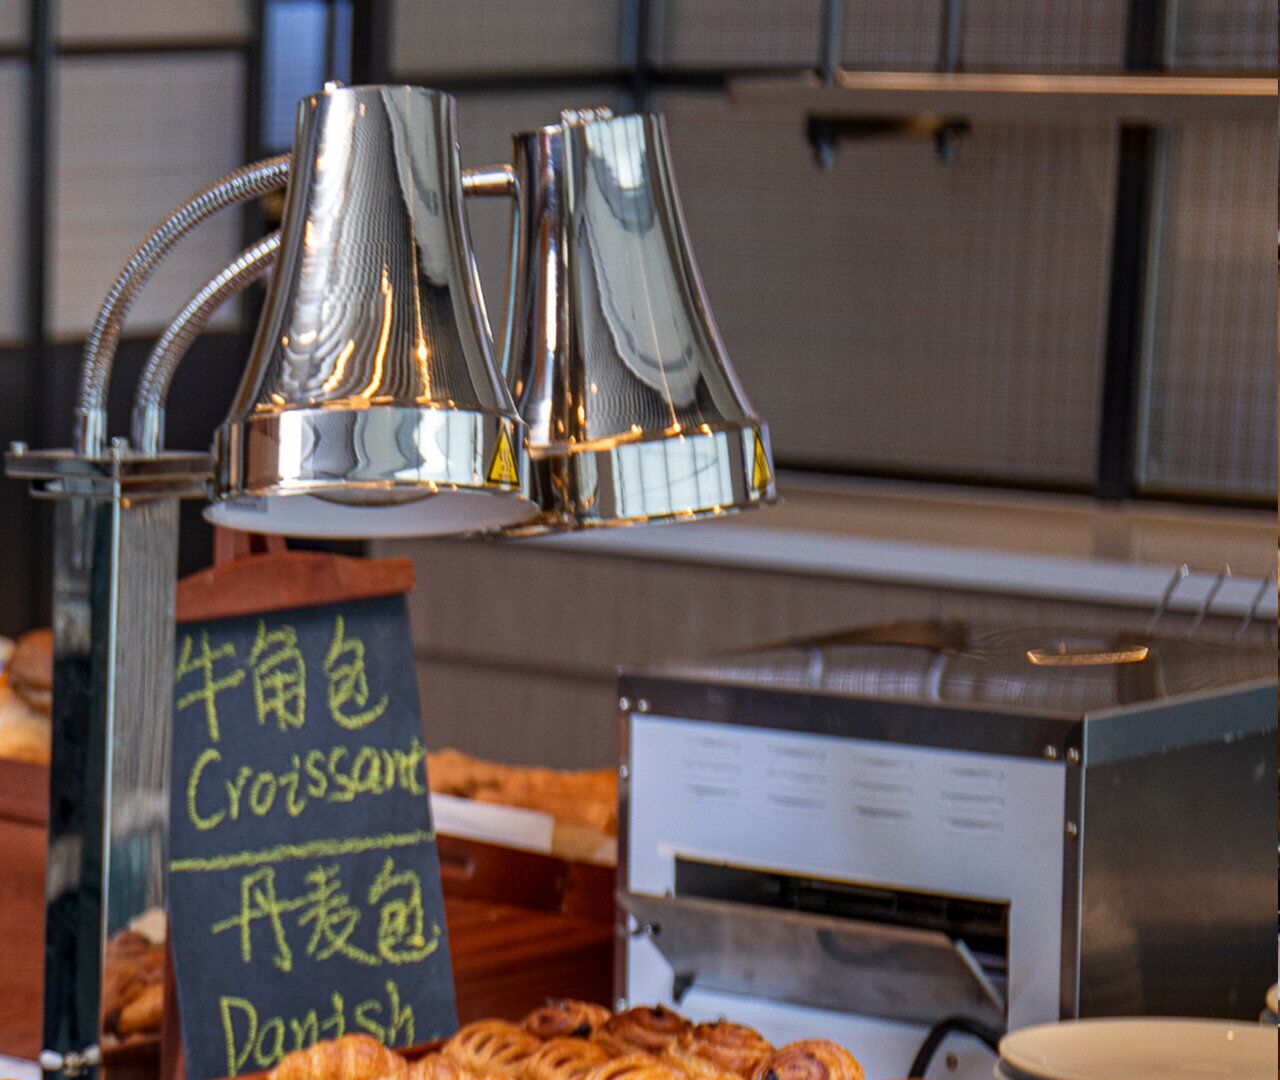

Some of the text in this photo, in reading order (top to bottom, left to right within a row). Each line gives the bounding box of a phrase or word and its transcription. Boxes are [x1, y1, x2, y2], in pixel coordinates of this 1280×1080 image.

[175, 615, 389, 742] 牛角包
[187, 736, 426, 830] Croissant
[211, 857, 441, 971] 丹麦包
[220, 979, 416, 1077] Danish
